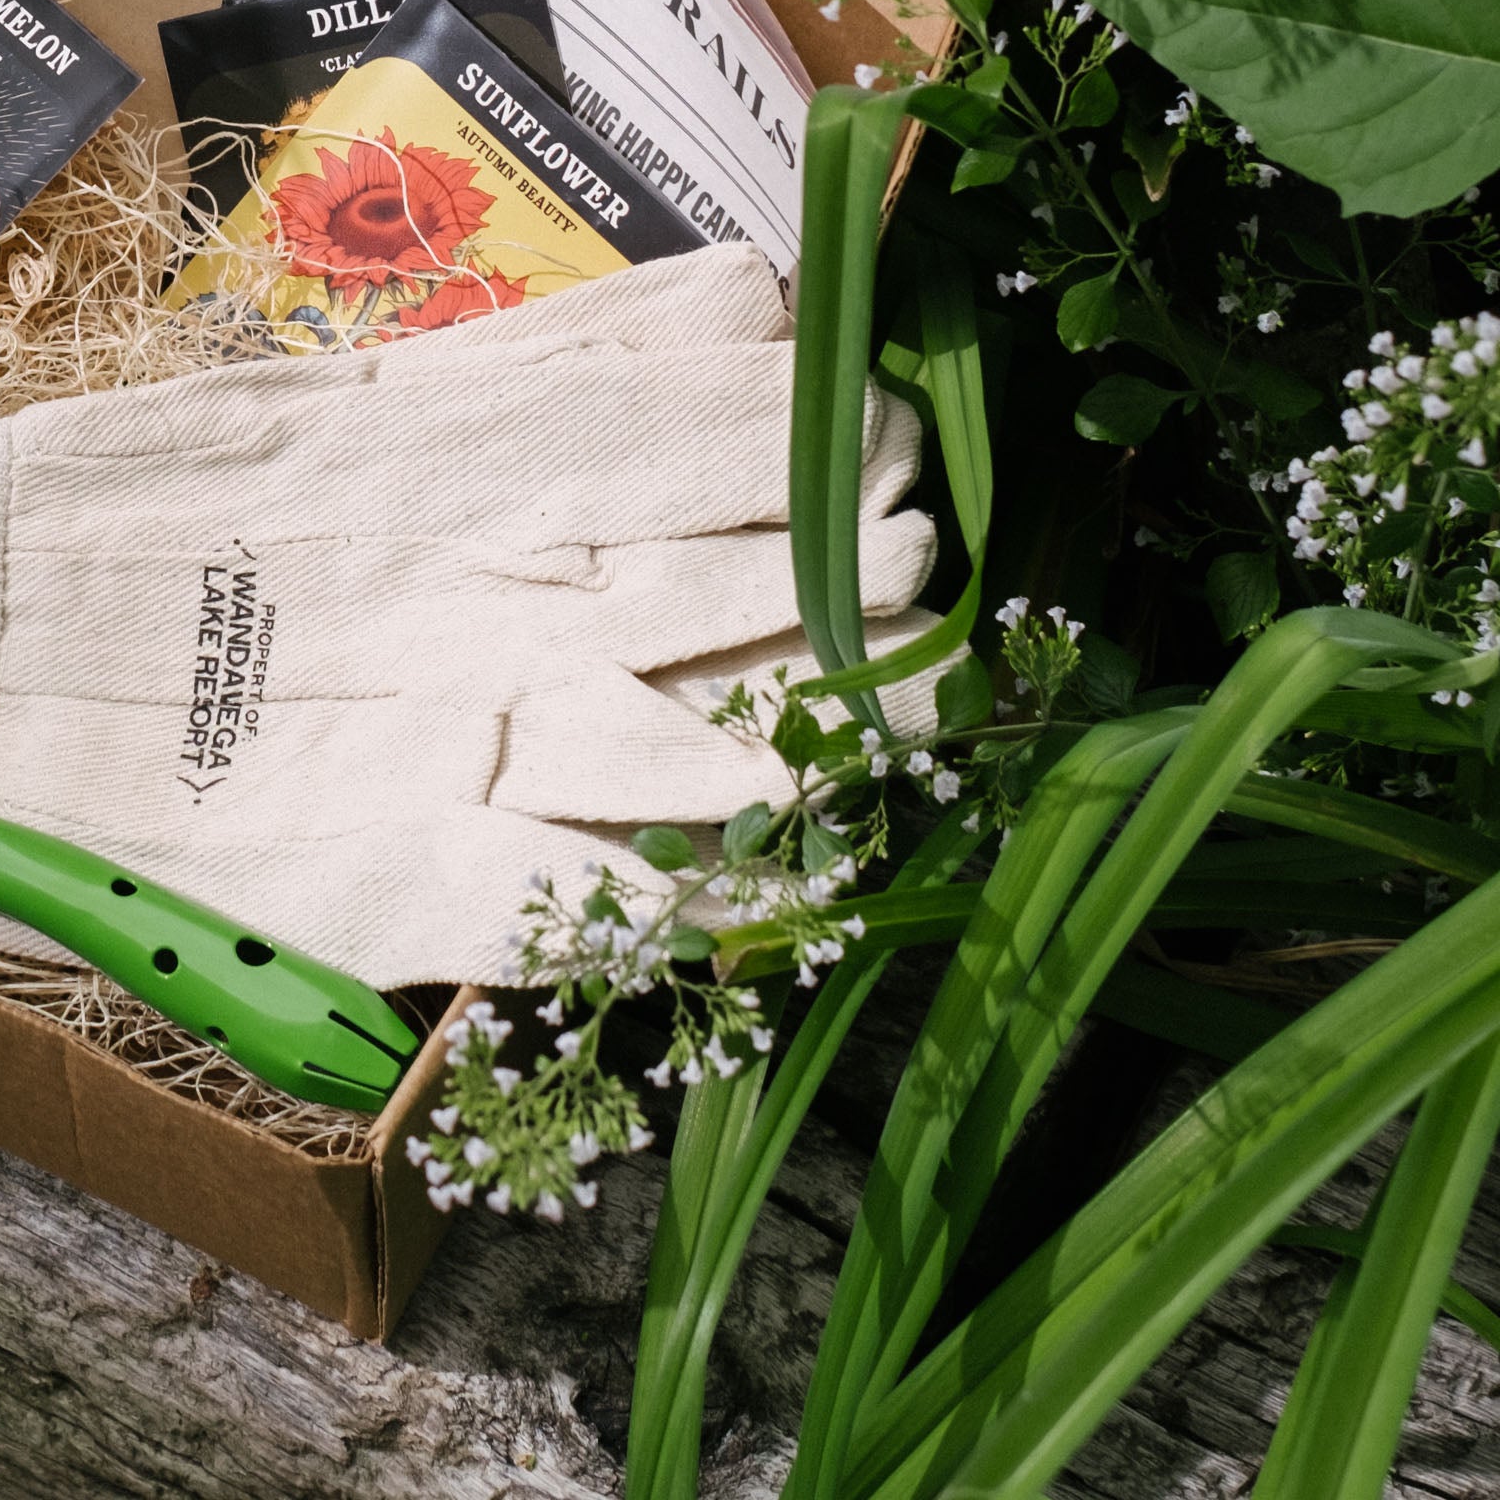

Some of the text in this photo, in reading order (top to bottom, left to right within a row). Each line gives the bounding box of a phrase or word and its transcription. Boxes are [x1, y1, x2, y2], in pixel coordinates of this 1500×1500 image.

[456, 62, 630, 230] SUNFLOWER
[456, 120, 578, 234] ‘AUTUMN BEAUTY’
[563, 64, 621, 141] KING
[613, 120, 699, 207] HAPPY
[180, 565, 228, 770] LAKE RESORT
